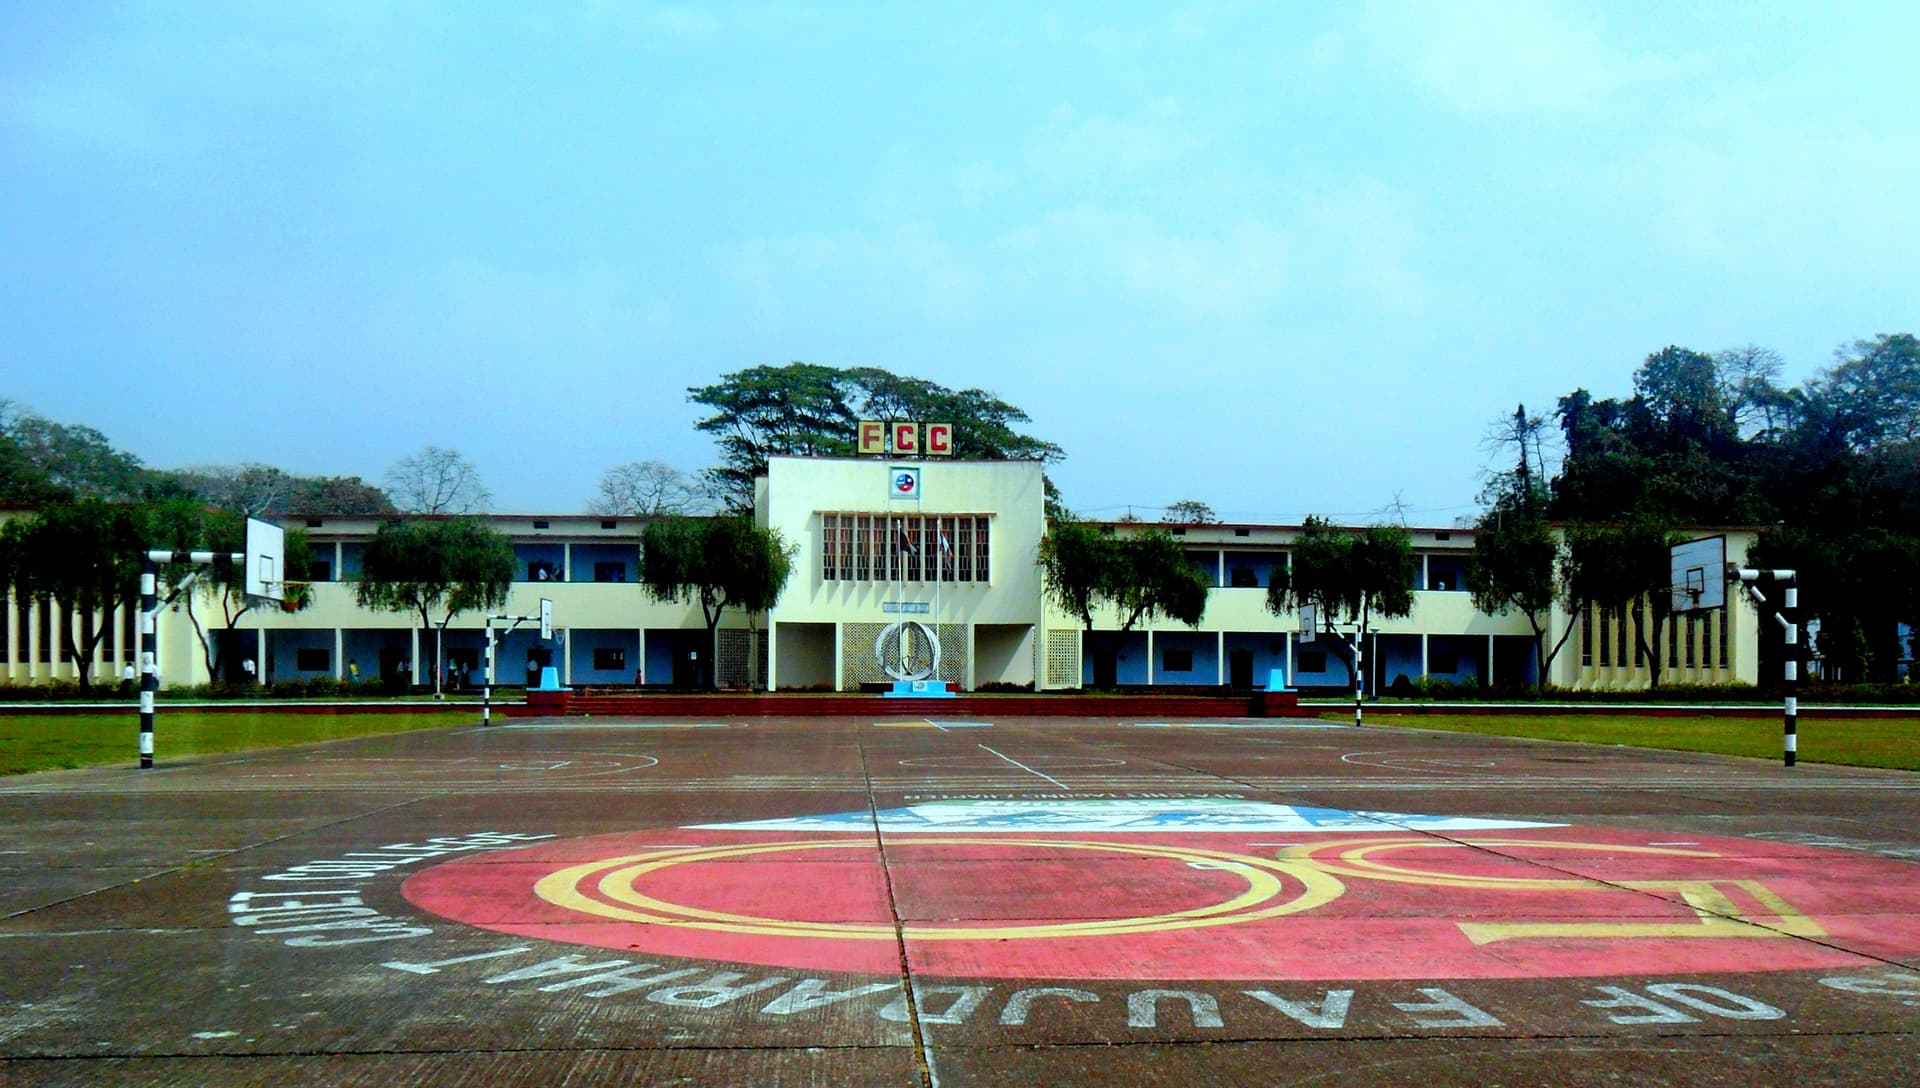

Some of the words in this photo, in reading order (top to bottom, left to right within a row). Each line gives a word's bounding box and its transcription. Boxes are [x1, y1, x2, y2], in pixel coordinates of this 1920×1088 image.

[863, 425, 948, 451] FCC
[261, 831, 558, 881] COLLEGE
[228, 889, 433, 948] CADET
[379, 946, 1504, 1030] FAUJDARHAT
[1581, 982, 1787, 1025] OF
